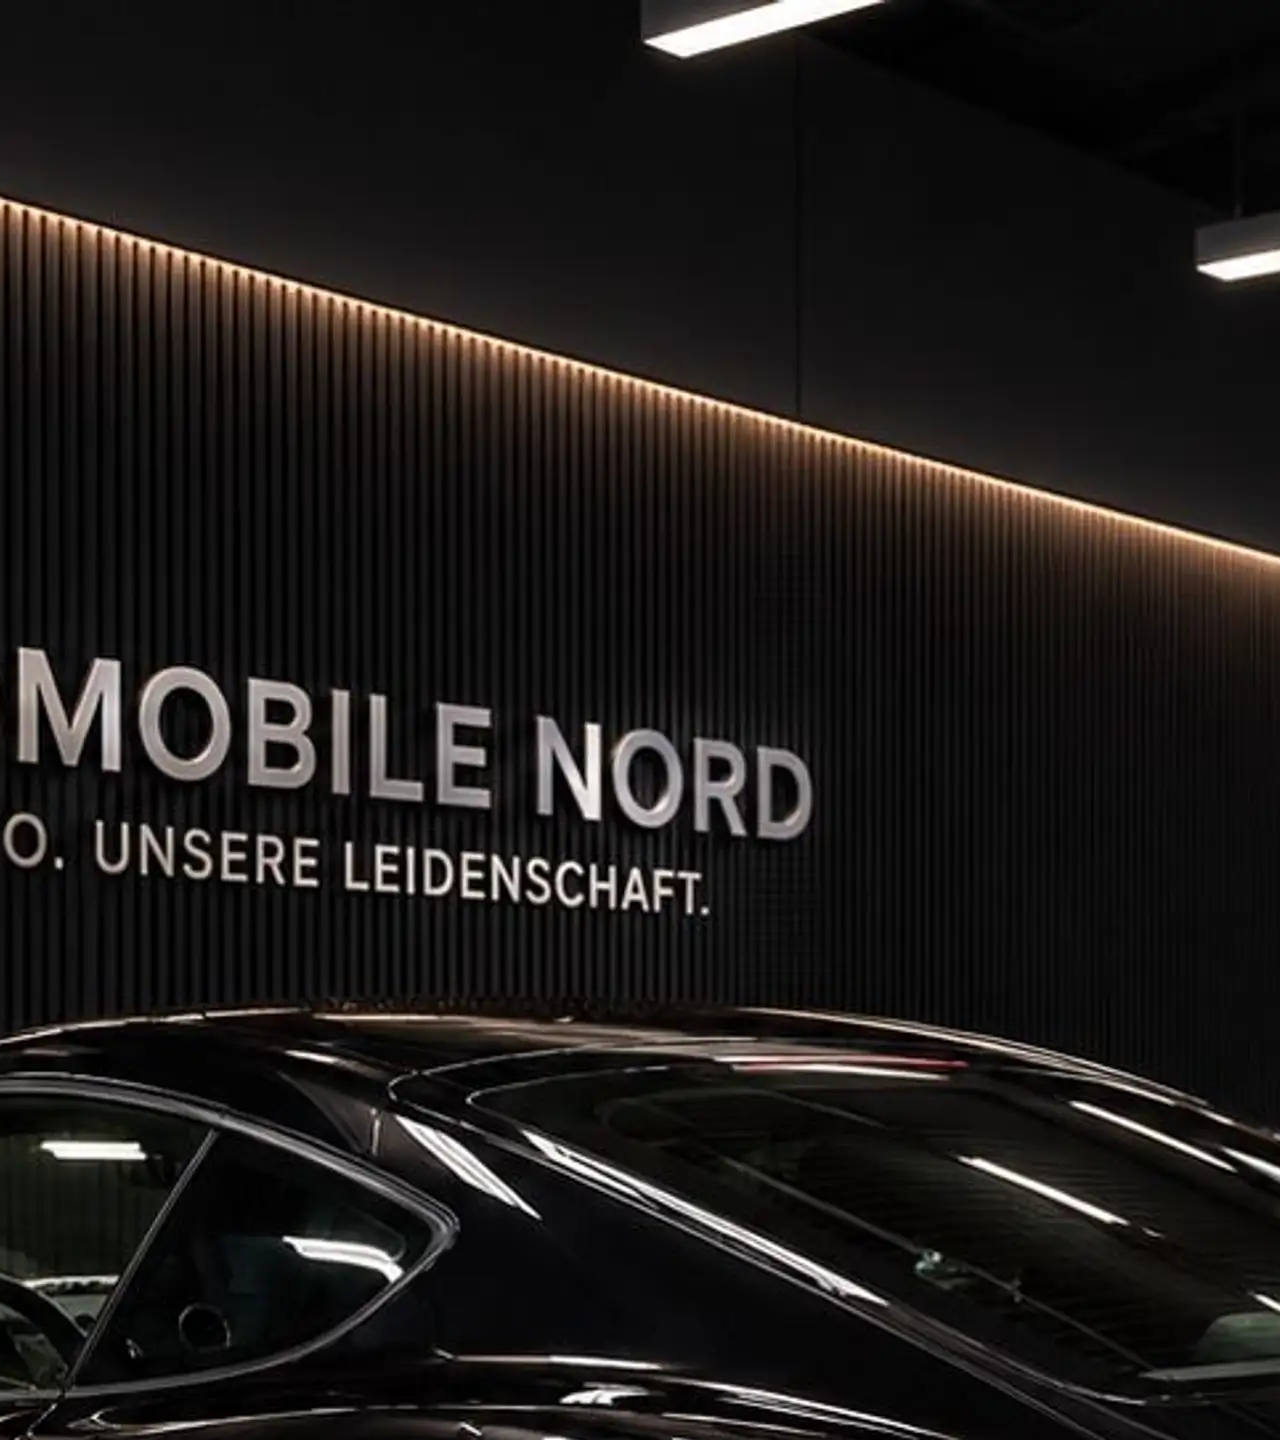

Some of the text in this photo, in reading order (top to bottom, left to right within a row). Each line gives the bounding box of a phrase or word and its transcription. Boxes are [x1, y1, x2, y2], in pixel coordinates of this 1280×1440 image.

[535, 714, 814, 841] NORD
[95, 819, 321, 888] UNSERE
[344, 840, 712, 918] LEIDENSCHAFT.
